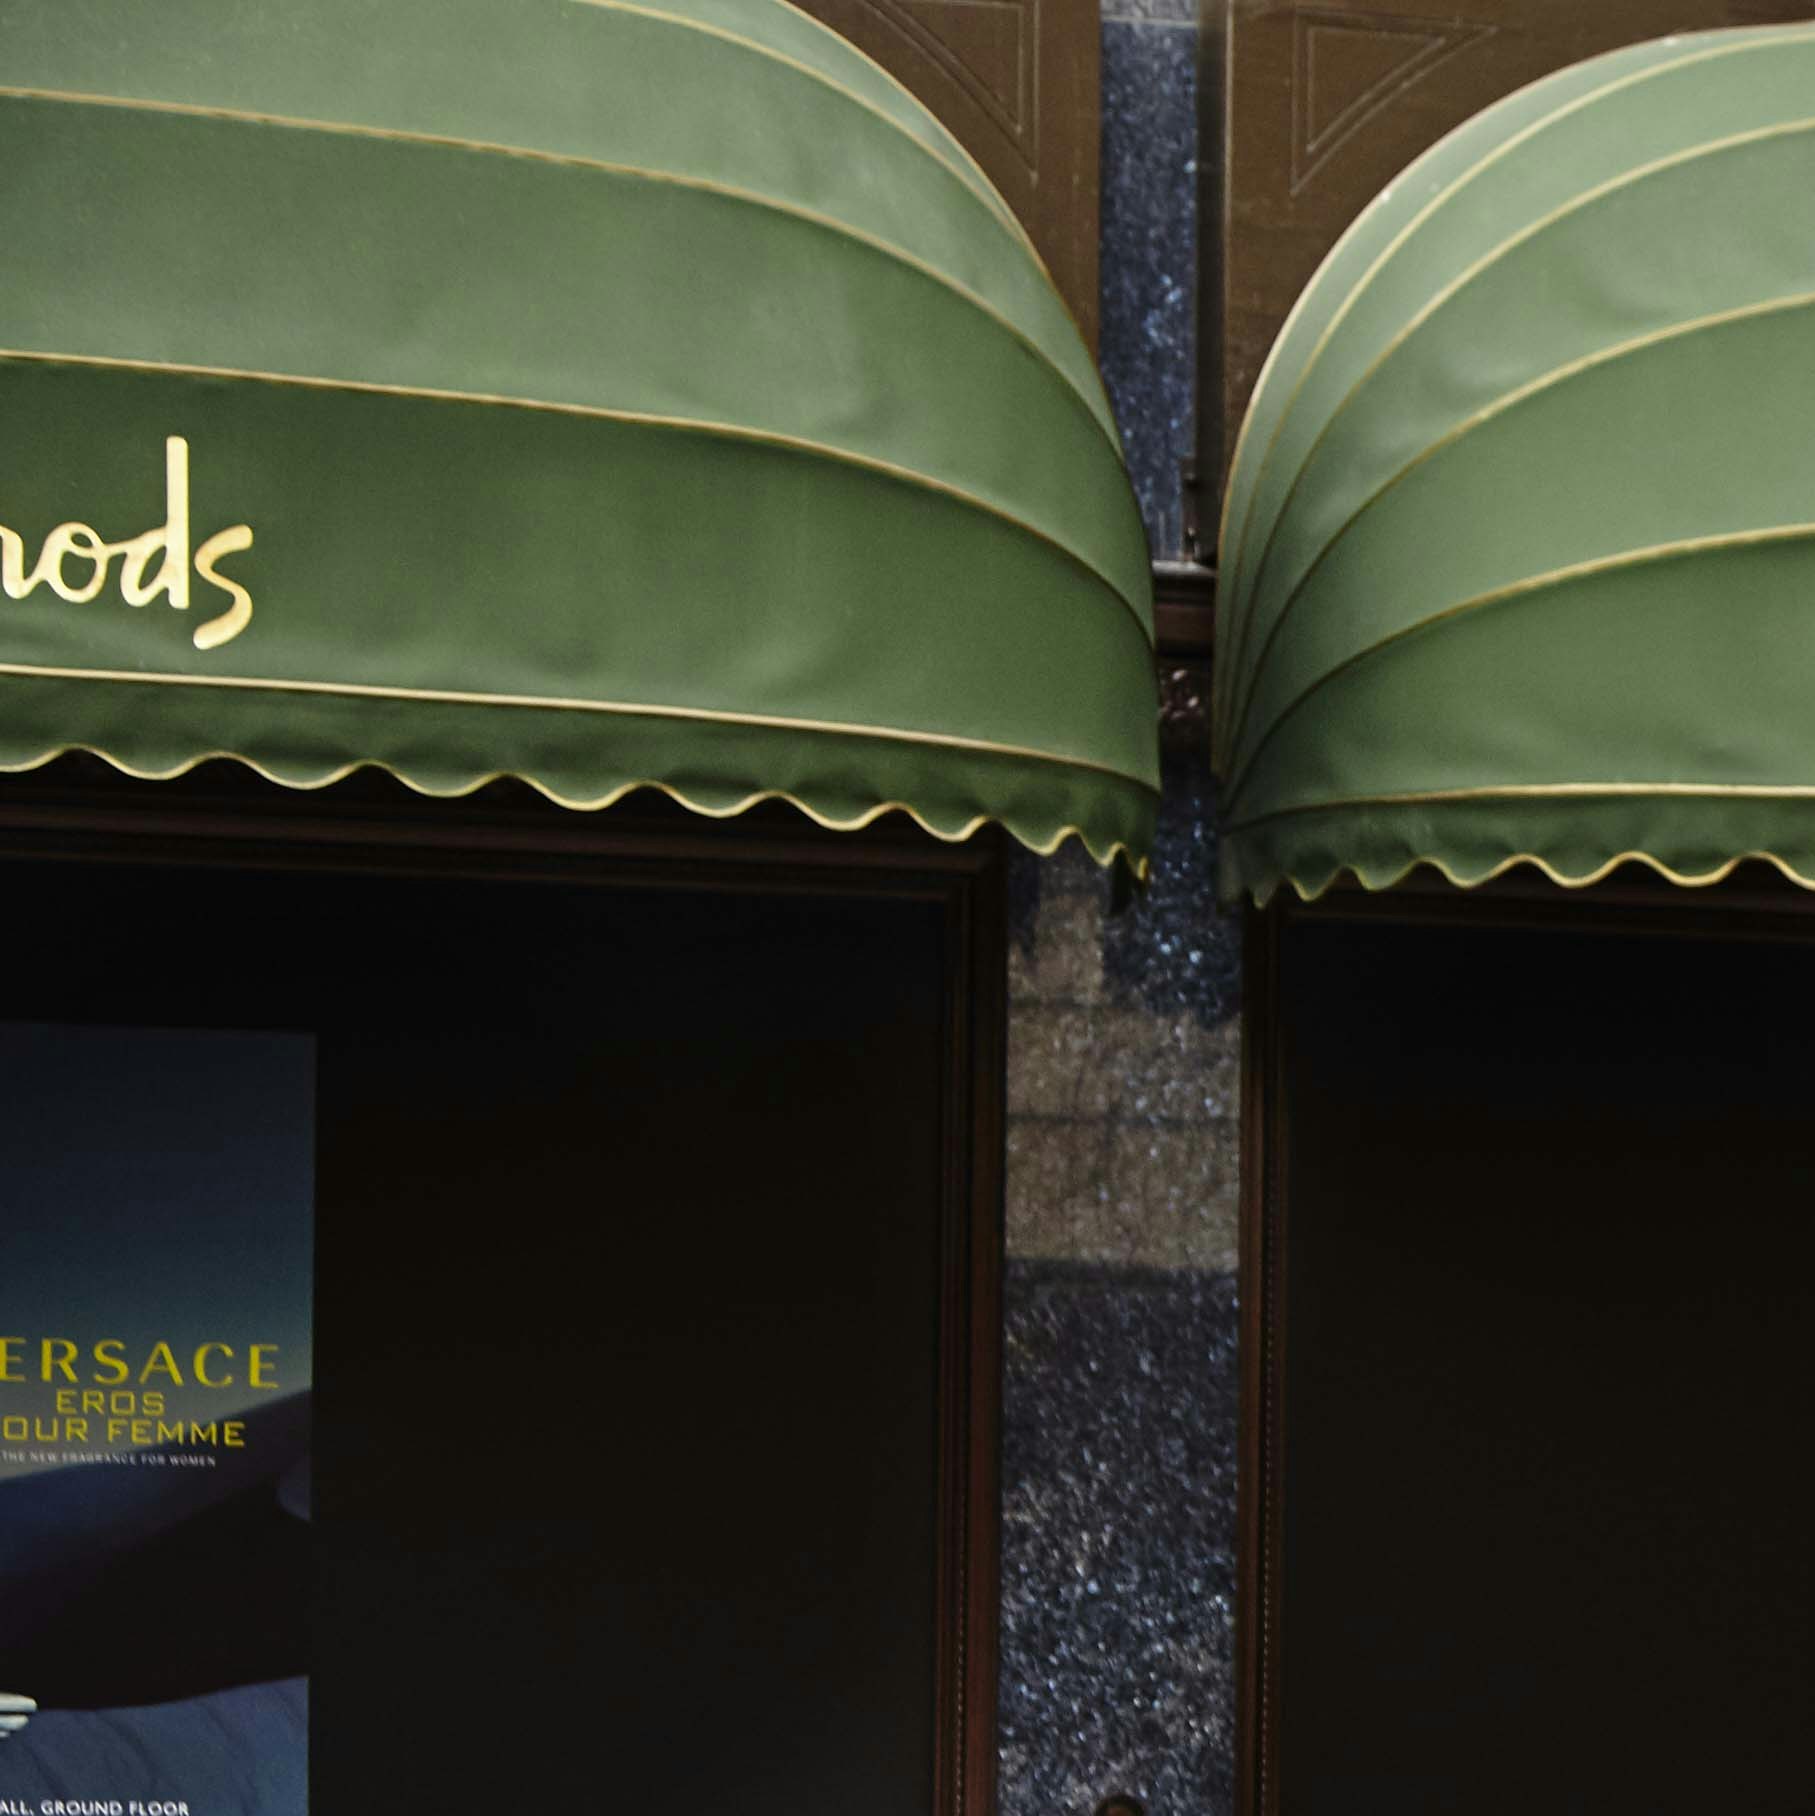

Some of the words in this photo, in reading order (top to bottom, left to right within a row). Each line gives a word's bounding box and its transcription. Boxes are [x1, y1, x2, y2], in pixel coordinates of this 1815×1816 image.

[0, 1336, 280, 1389] ERSACE
[56, 1388, 165, 1416] EROS
[2, 1415, 89, 1442] OUR
[107, 1418, 246, 1447] FEMME
[141, 1454, 165, 1466] FOR
[169, 1455, 216, 1468] WOMEN
